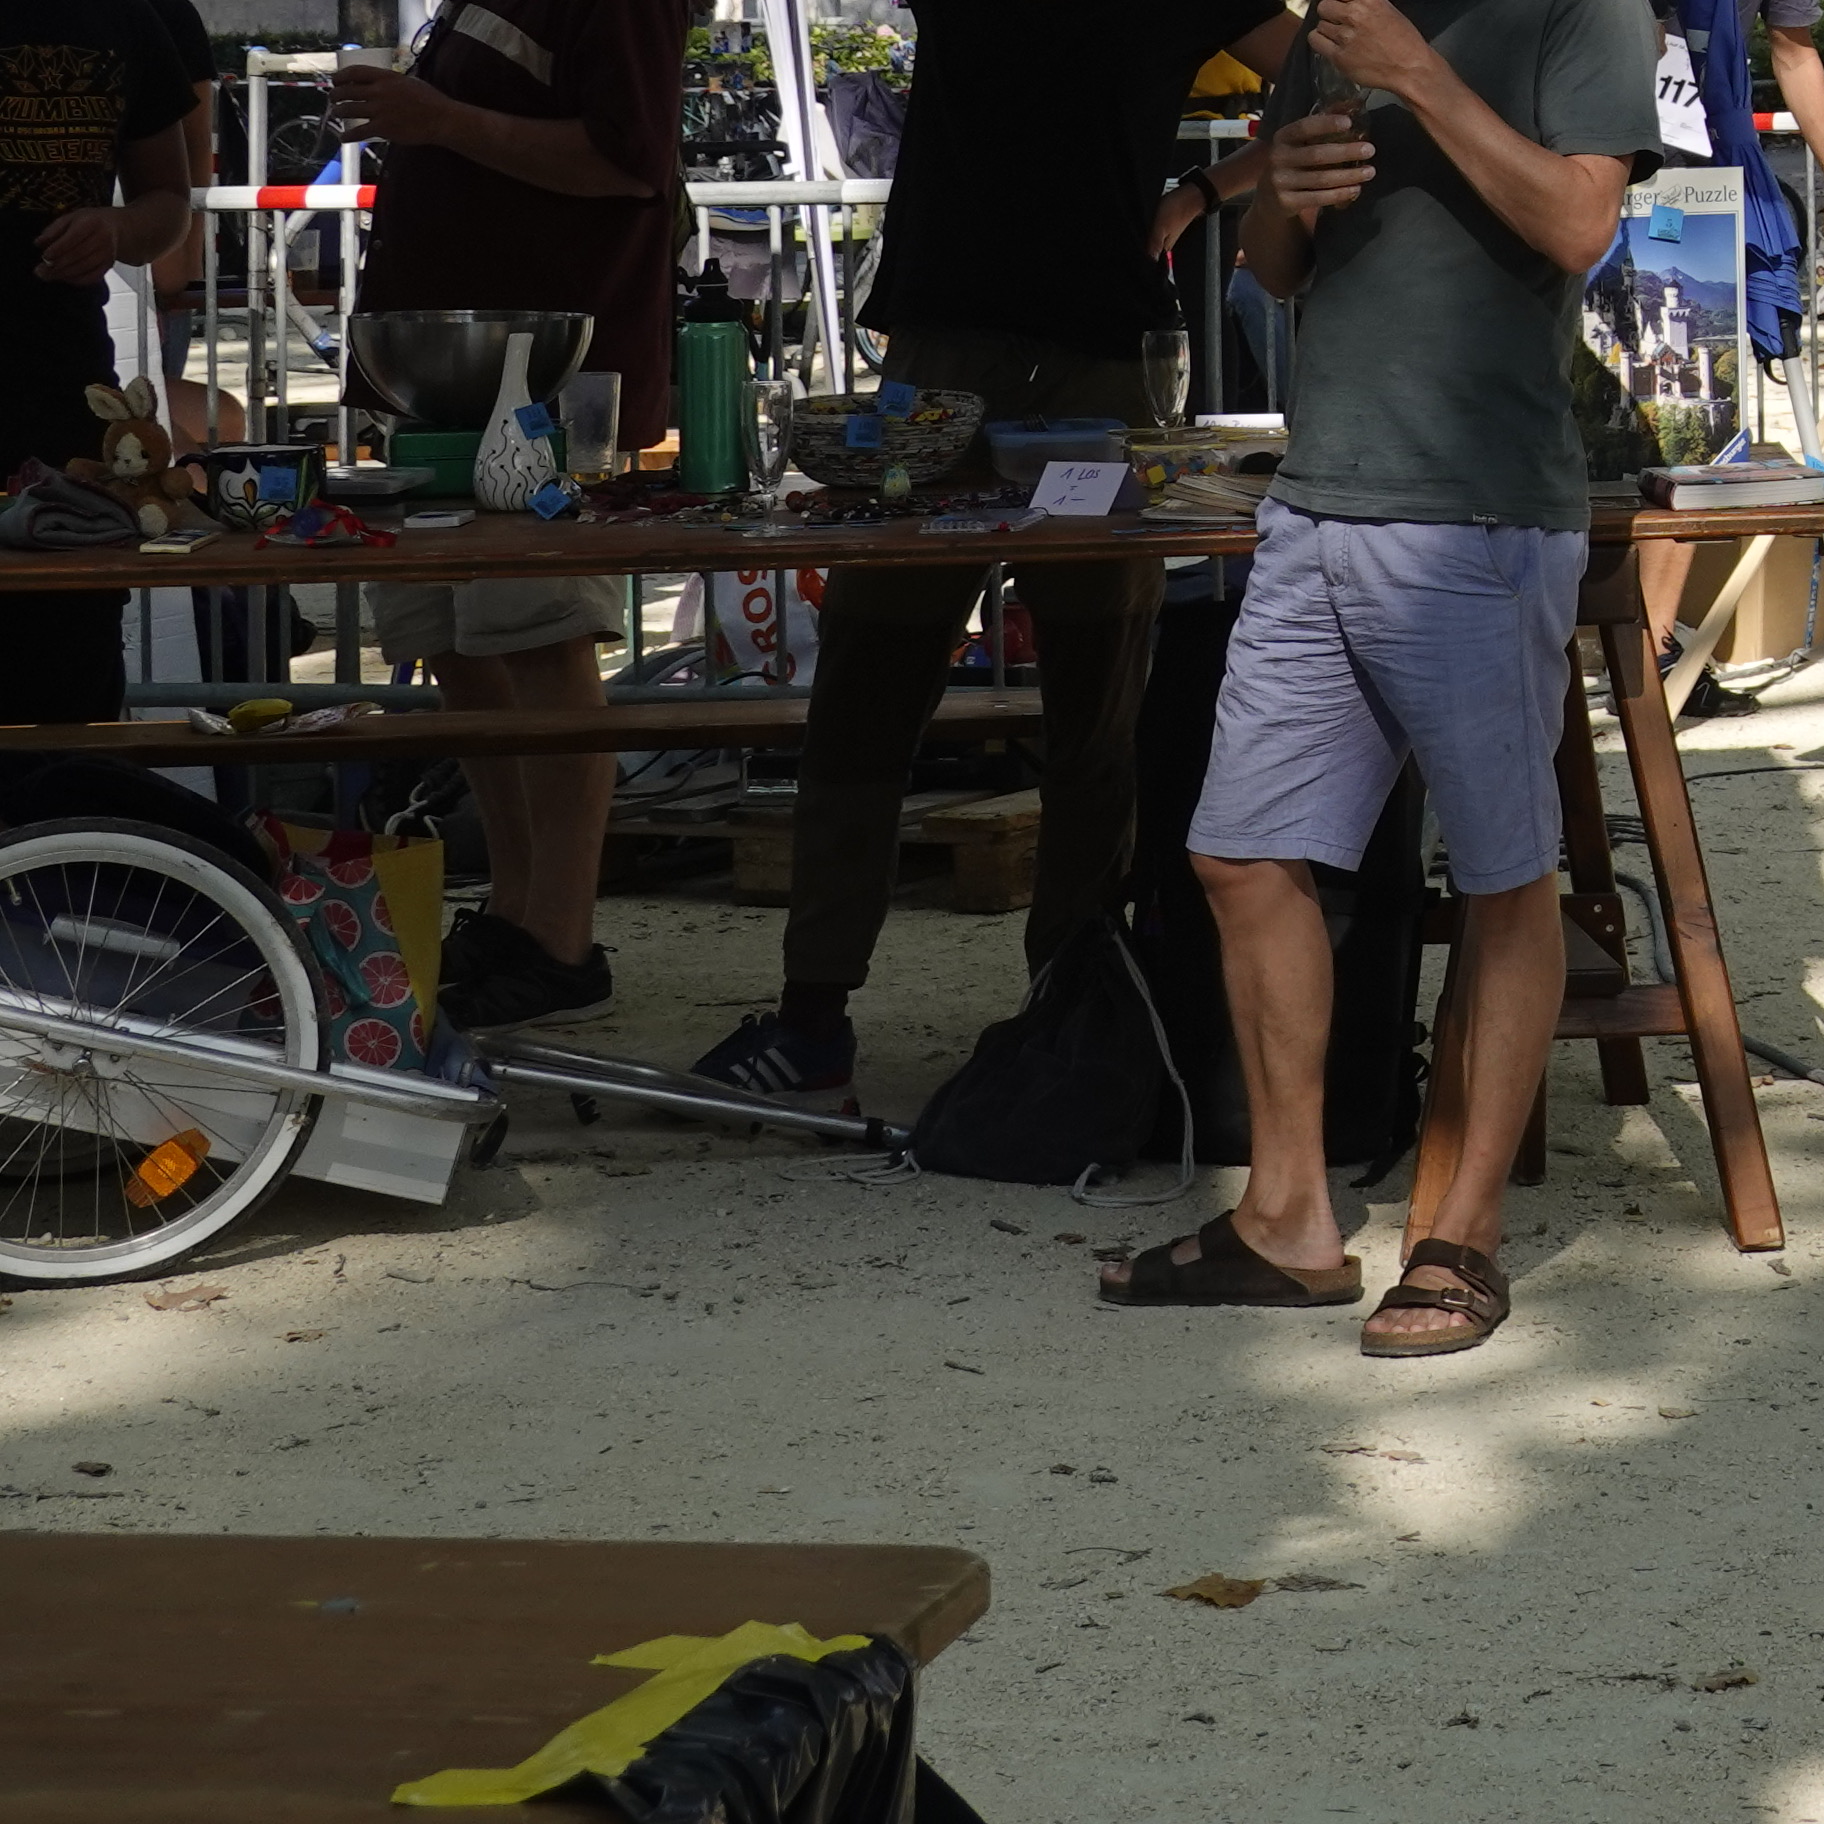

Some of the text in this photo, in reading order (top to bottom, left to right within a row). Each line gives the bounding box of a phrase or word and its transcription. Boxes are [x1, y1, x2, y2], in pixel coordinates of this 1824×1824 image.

[1659, 75, 1700, 107] 117
[1684, 184, 1738, 204] Puzzle
[1077, 468, 1101, 481] LOS
